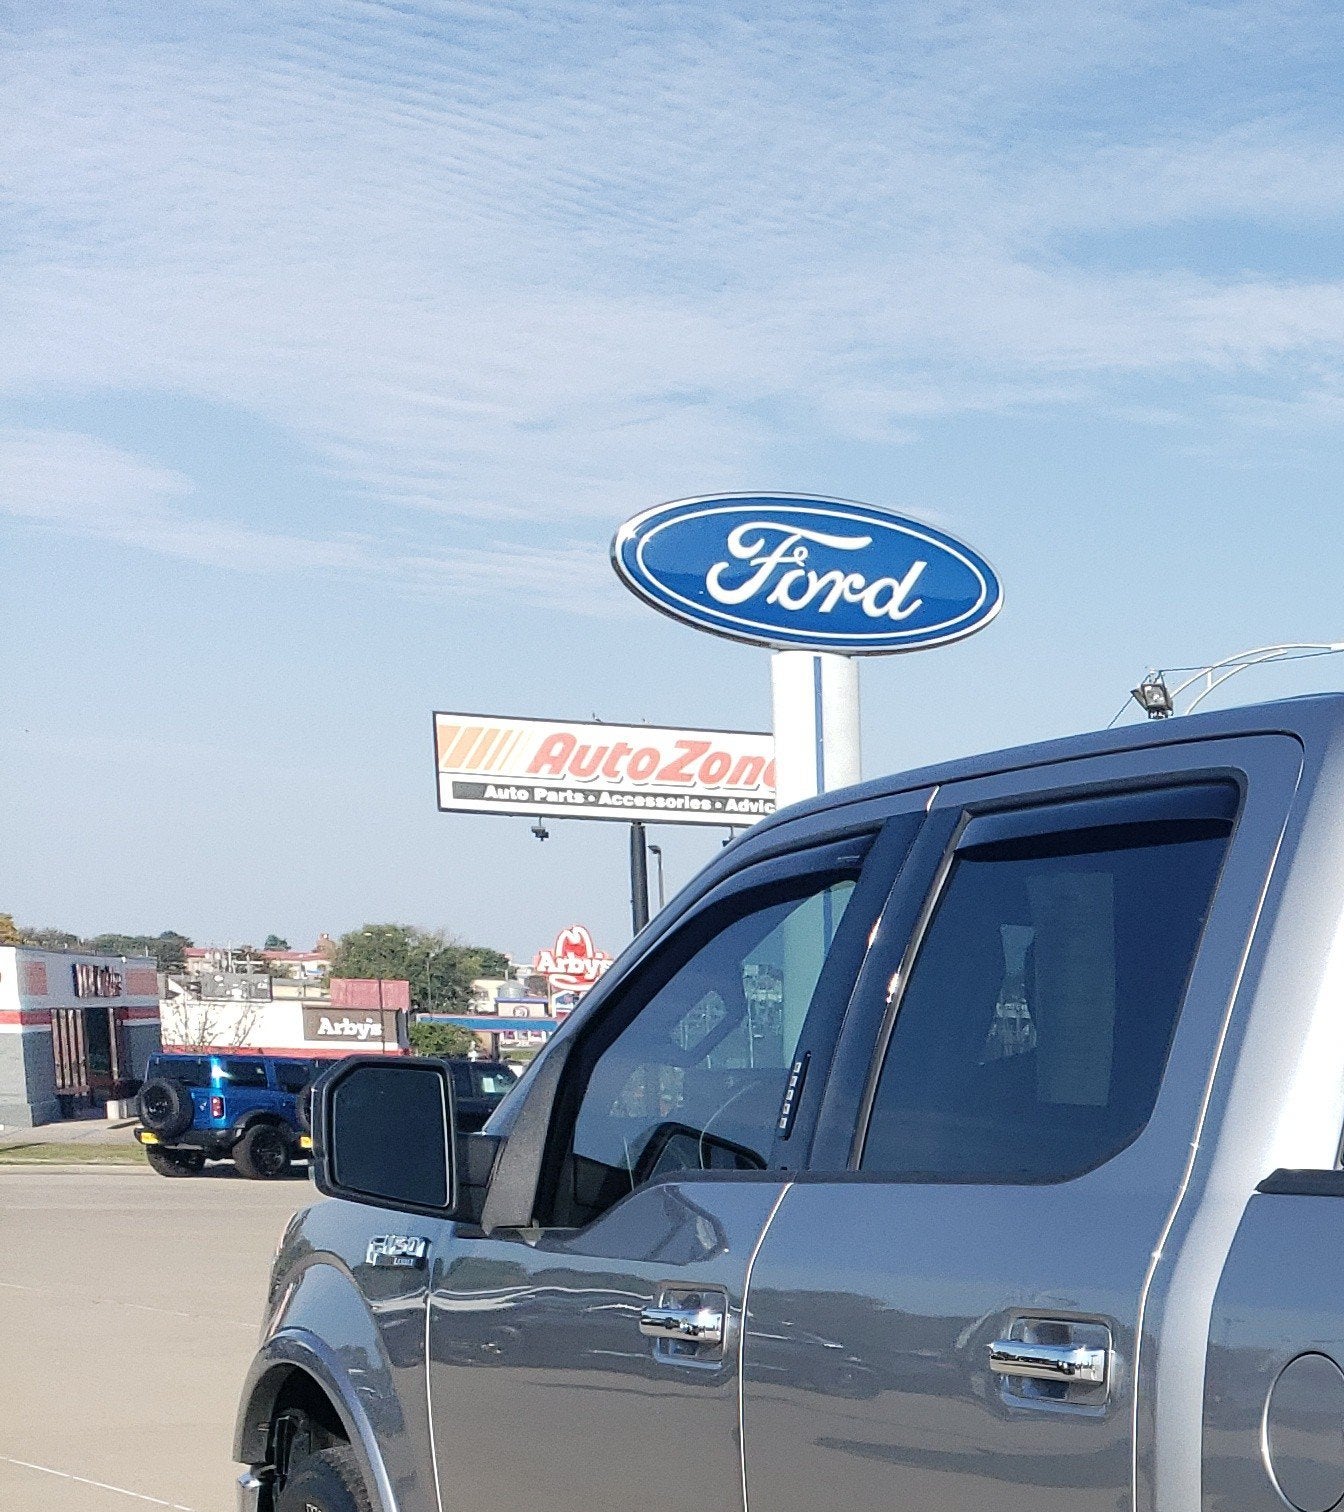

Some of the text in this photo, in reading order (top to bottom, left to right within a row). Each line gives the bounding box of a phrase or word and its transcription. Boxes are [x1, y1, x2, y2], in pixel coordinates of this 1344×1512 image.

[706, 521, 927, 621] Ford
[482, 784, 529, 801] Auto
[534, 787, 585, 804] Parts
[600, 791, 712, 811] Accessories
[318, 1017, 383, 1040] Arby's
